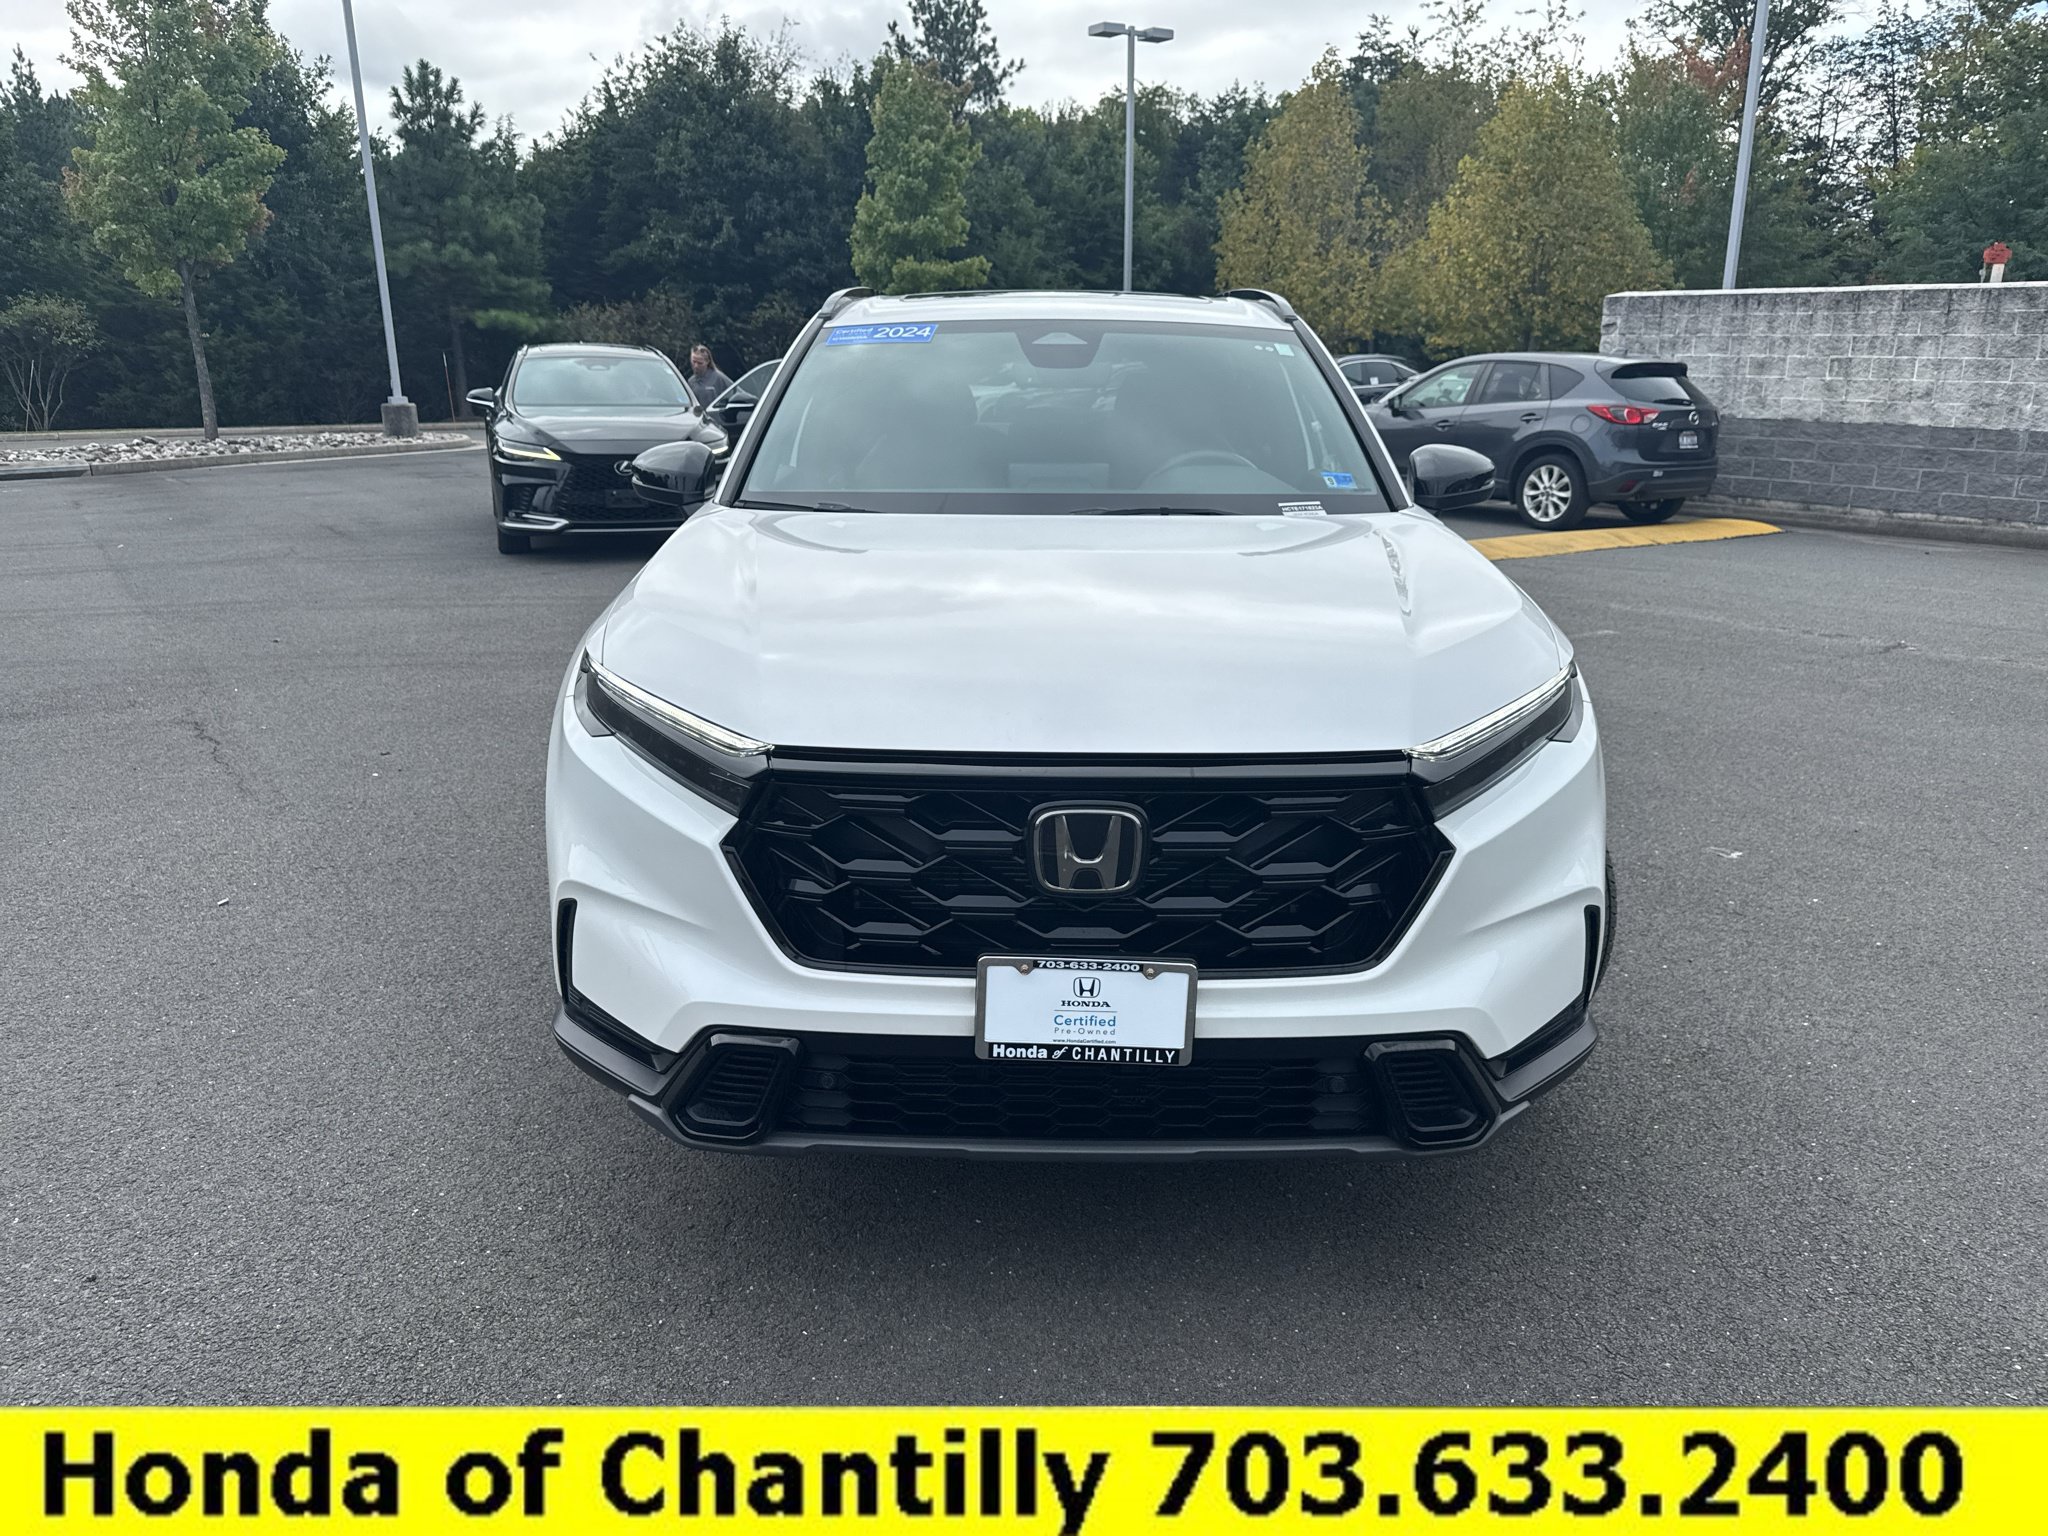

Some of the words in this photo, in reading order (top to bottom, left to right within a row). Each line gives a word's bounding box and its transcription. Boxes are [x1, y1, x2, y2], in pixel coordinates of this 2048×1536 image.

[873, 326, 931, 338] 2024
[1037, 960, 1140, 972] 703-633-2400
[1061, 1000, 1111, 1008] HONDA
[1054, 1014, 1116, 1027] Certified
[1054, 1027, 1116, 1036] Pre-Owned
[992, 1044, 1048, 1059] Honda
[1051, 1046, 1069, 1060] of
[1071, 1047, 1176, 1064] CHANTILLY
